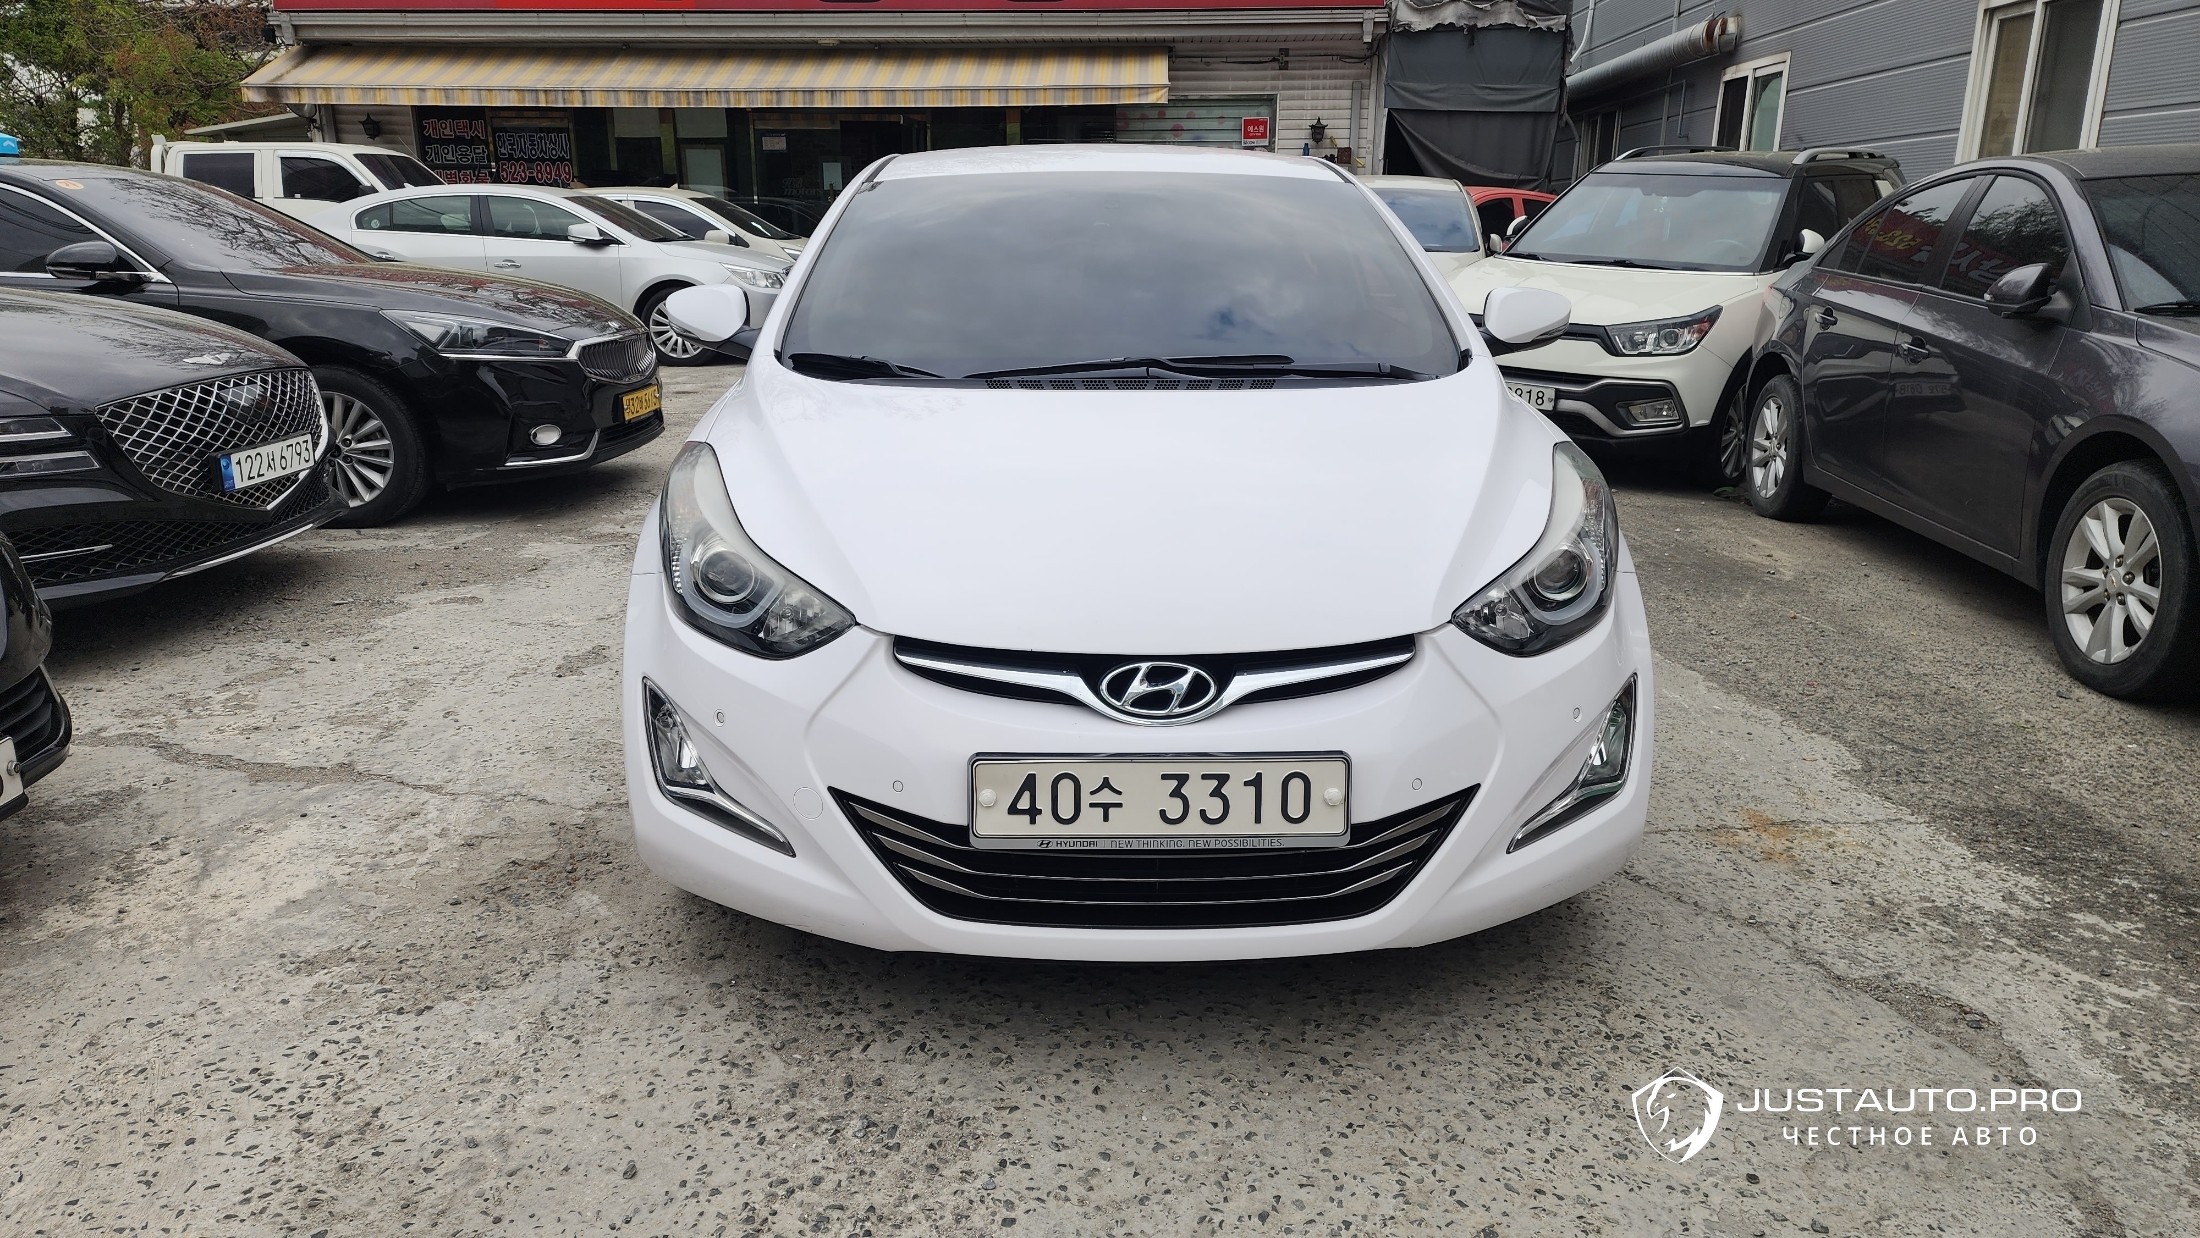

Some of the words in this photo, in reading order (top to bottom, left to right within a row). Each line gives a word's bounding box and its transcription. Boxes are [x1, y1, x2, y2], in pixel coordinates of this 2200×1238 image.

[423, 119, 486, 140] 개인택시
[425, 144, 488, 164] 개인용달
[496, 132, 570, 159] 한국자동차상사
[499, 160, 572, 183] 523-8949
[236, 451, 276, 482] 122서
[279, 440, 310, 470] 6793
[1007, 771, 1123, 825] 40수
[1158, 771, 1312, 825] 3310
[1055, 840, 1098, 848] HYUNDAI
[1110, 840, 1133, 848] NEW
[1134, 839, 1185, 848] THINKING.
[1187, 839, 1211, 848] NEW
[1213, 838, 1285, 848] POSSIBILITIES.
